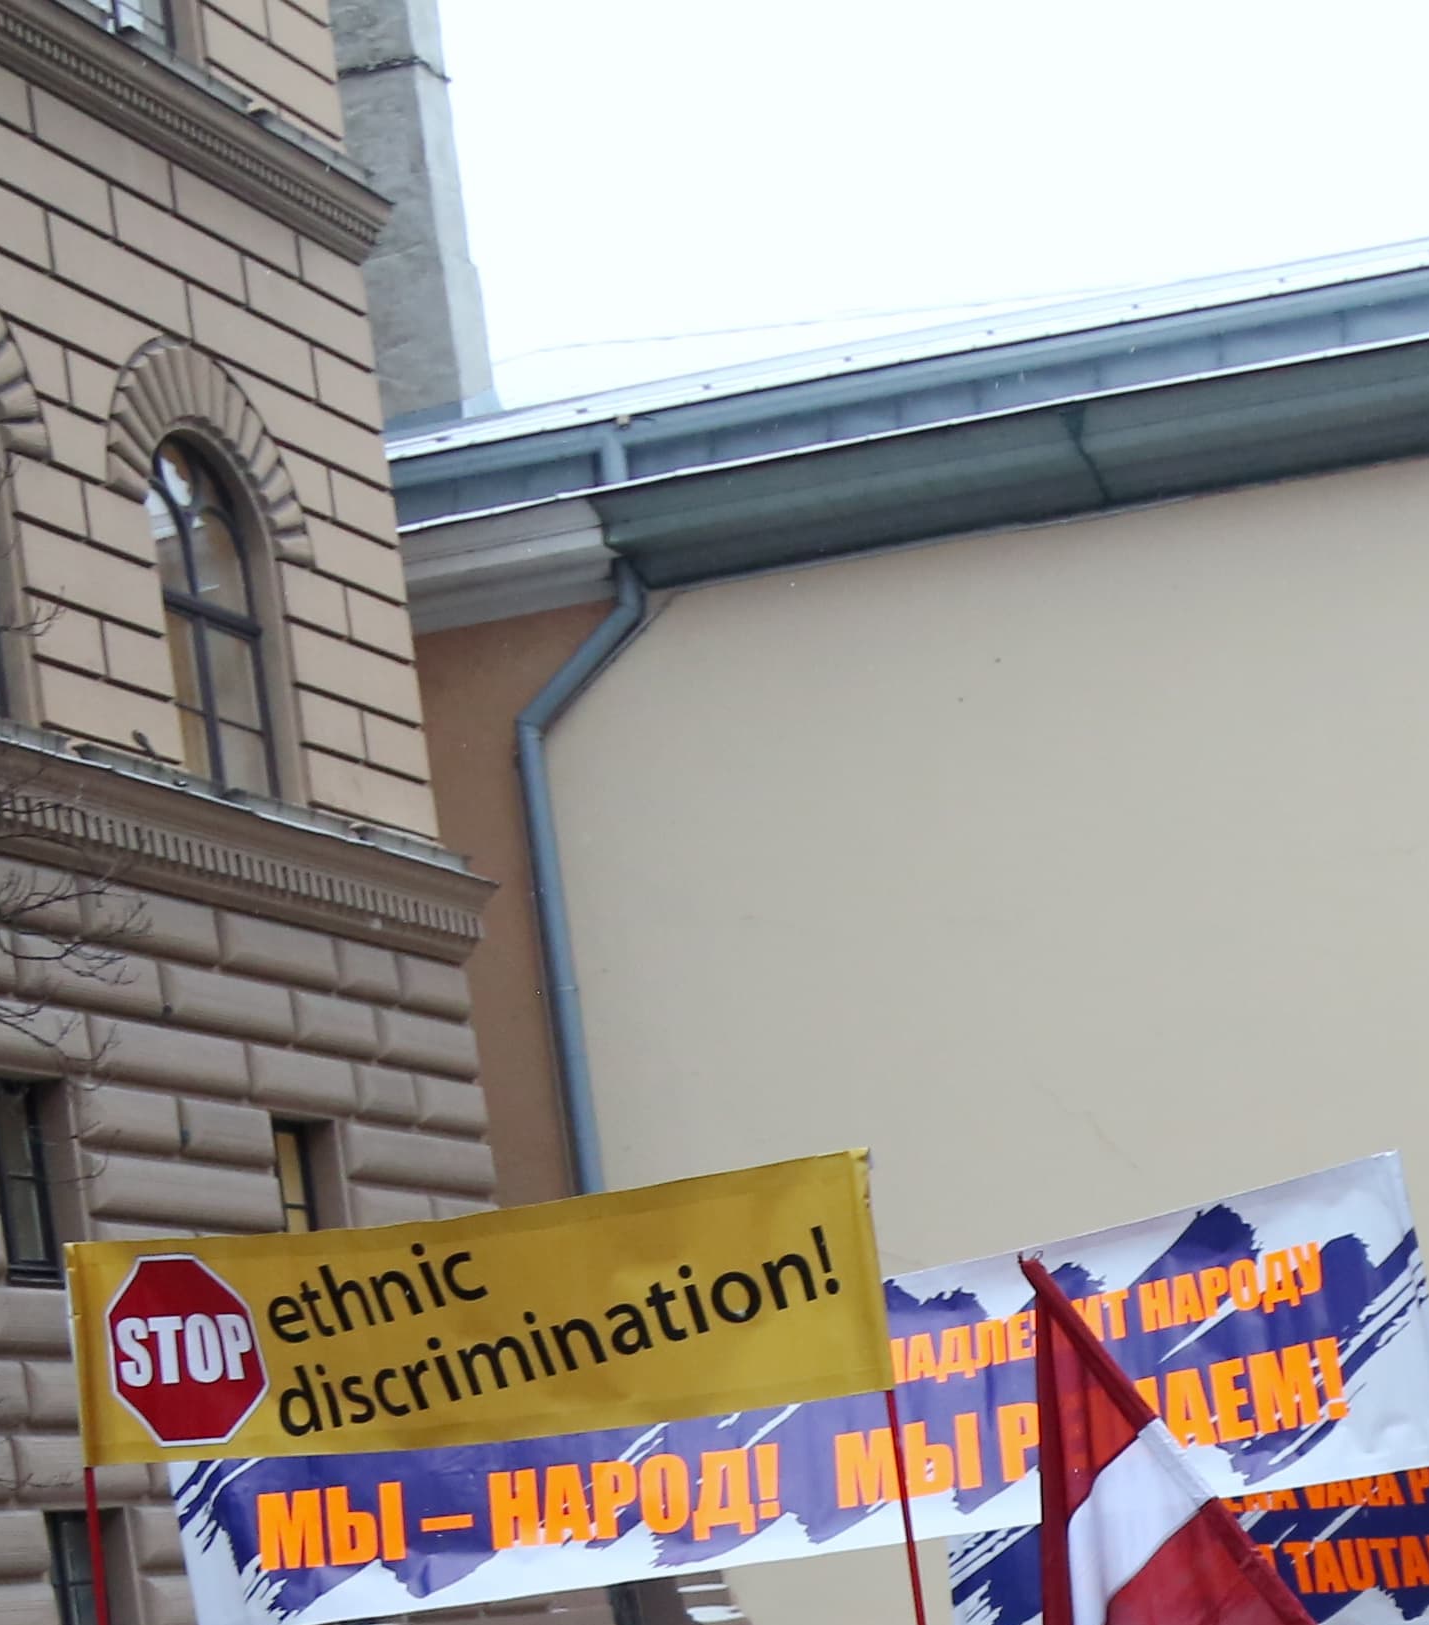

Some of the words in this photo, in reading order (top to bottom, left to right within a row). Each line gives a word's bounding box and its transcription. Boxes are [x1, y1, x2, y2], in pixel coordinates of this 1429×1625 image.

[267, 1243, 489, 1344] ethnic
[277, 1225, 842, 1437] discrimination!
[1139, 1240, 1324, 1334] НАРОДУ
[113, 1312, 253, 1386] STOP
[255, 1481, 408, 1571] МЫ
[488, 1442, 781, 1550] НАРОД!
[834, 1411, 984, 1510] МЫ
[997, 1336, 1349, 1483] РАЕМ!
